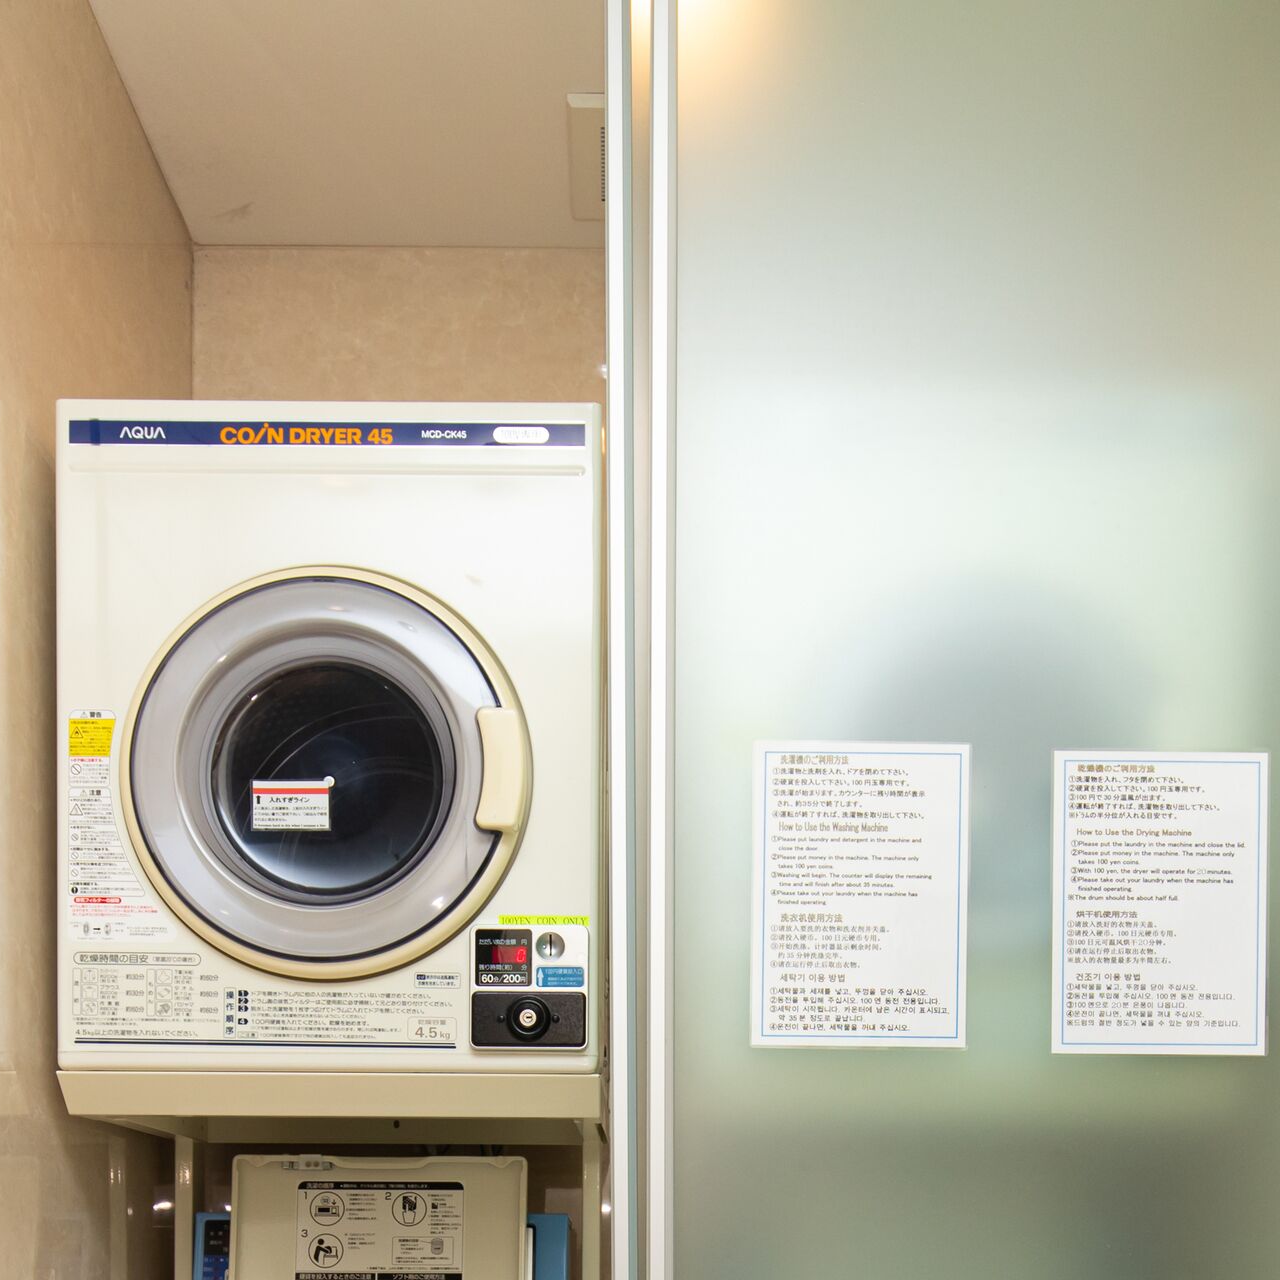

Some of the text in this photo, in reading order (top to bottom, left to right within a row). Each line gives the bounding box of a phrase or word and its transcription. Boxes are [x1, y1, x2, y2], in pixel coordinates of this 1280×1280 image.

[120, 427, 166, 439] AQUA
[220, 422, 393, 445] COIN DRYER 45
[421, 430, 467, 440] MCD-CK45
[779, 822, 888, 833] How to Use the Washing Machine
[1136, 829, 1160, 837] Drying
[536, 917, 558, 925] COIN
[563, 917, 585, 925] ONLY
[79, 954, 149, 964] 乾燥時間の目安
[780, 974, 845, 983] 세탁기 이용 방법
[415, 1027, 451, 1039] 4.5 kg
[385, 1192, 392, 1200] 2
[301, 1229, 308, 1238] 3
